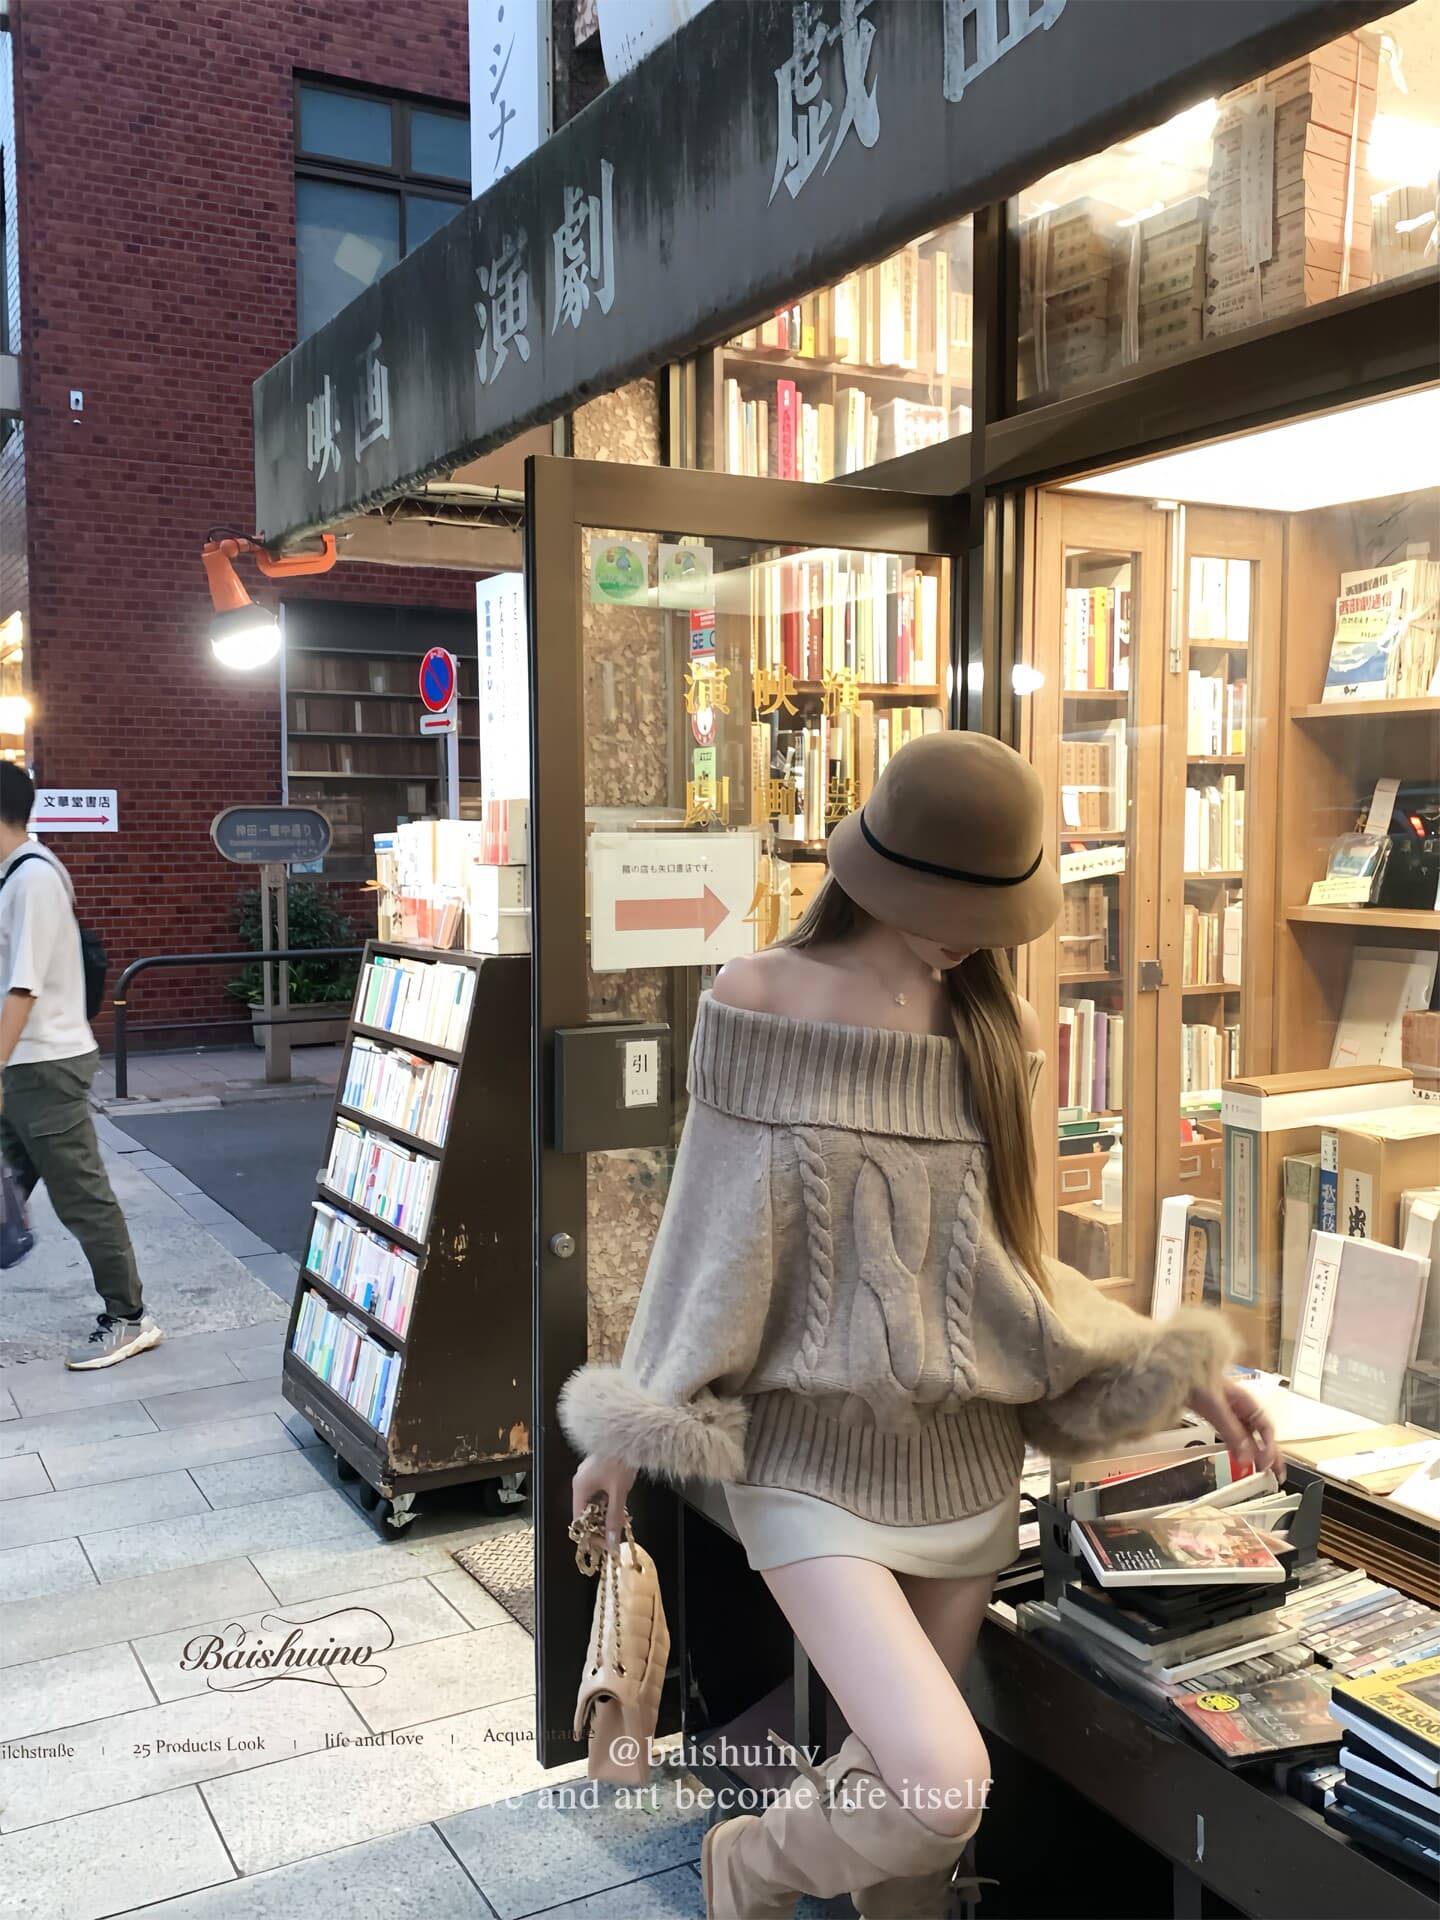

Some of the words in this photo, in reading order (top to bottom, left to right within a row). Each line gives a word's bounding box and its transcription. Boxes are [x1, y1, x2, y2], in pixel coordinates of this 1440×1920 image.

[306, 332, 391, 482] 映画
[474, 158, 616, 385] 演劇
[633, 1054, 648, 1073] 引
